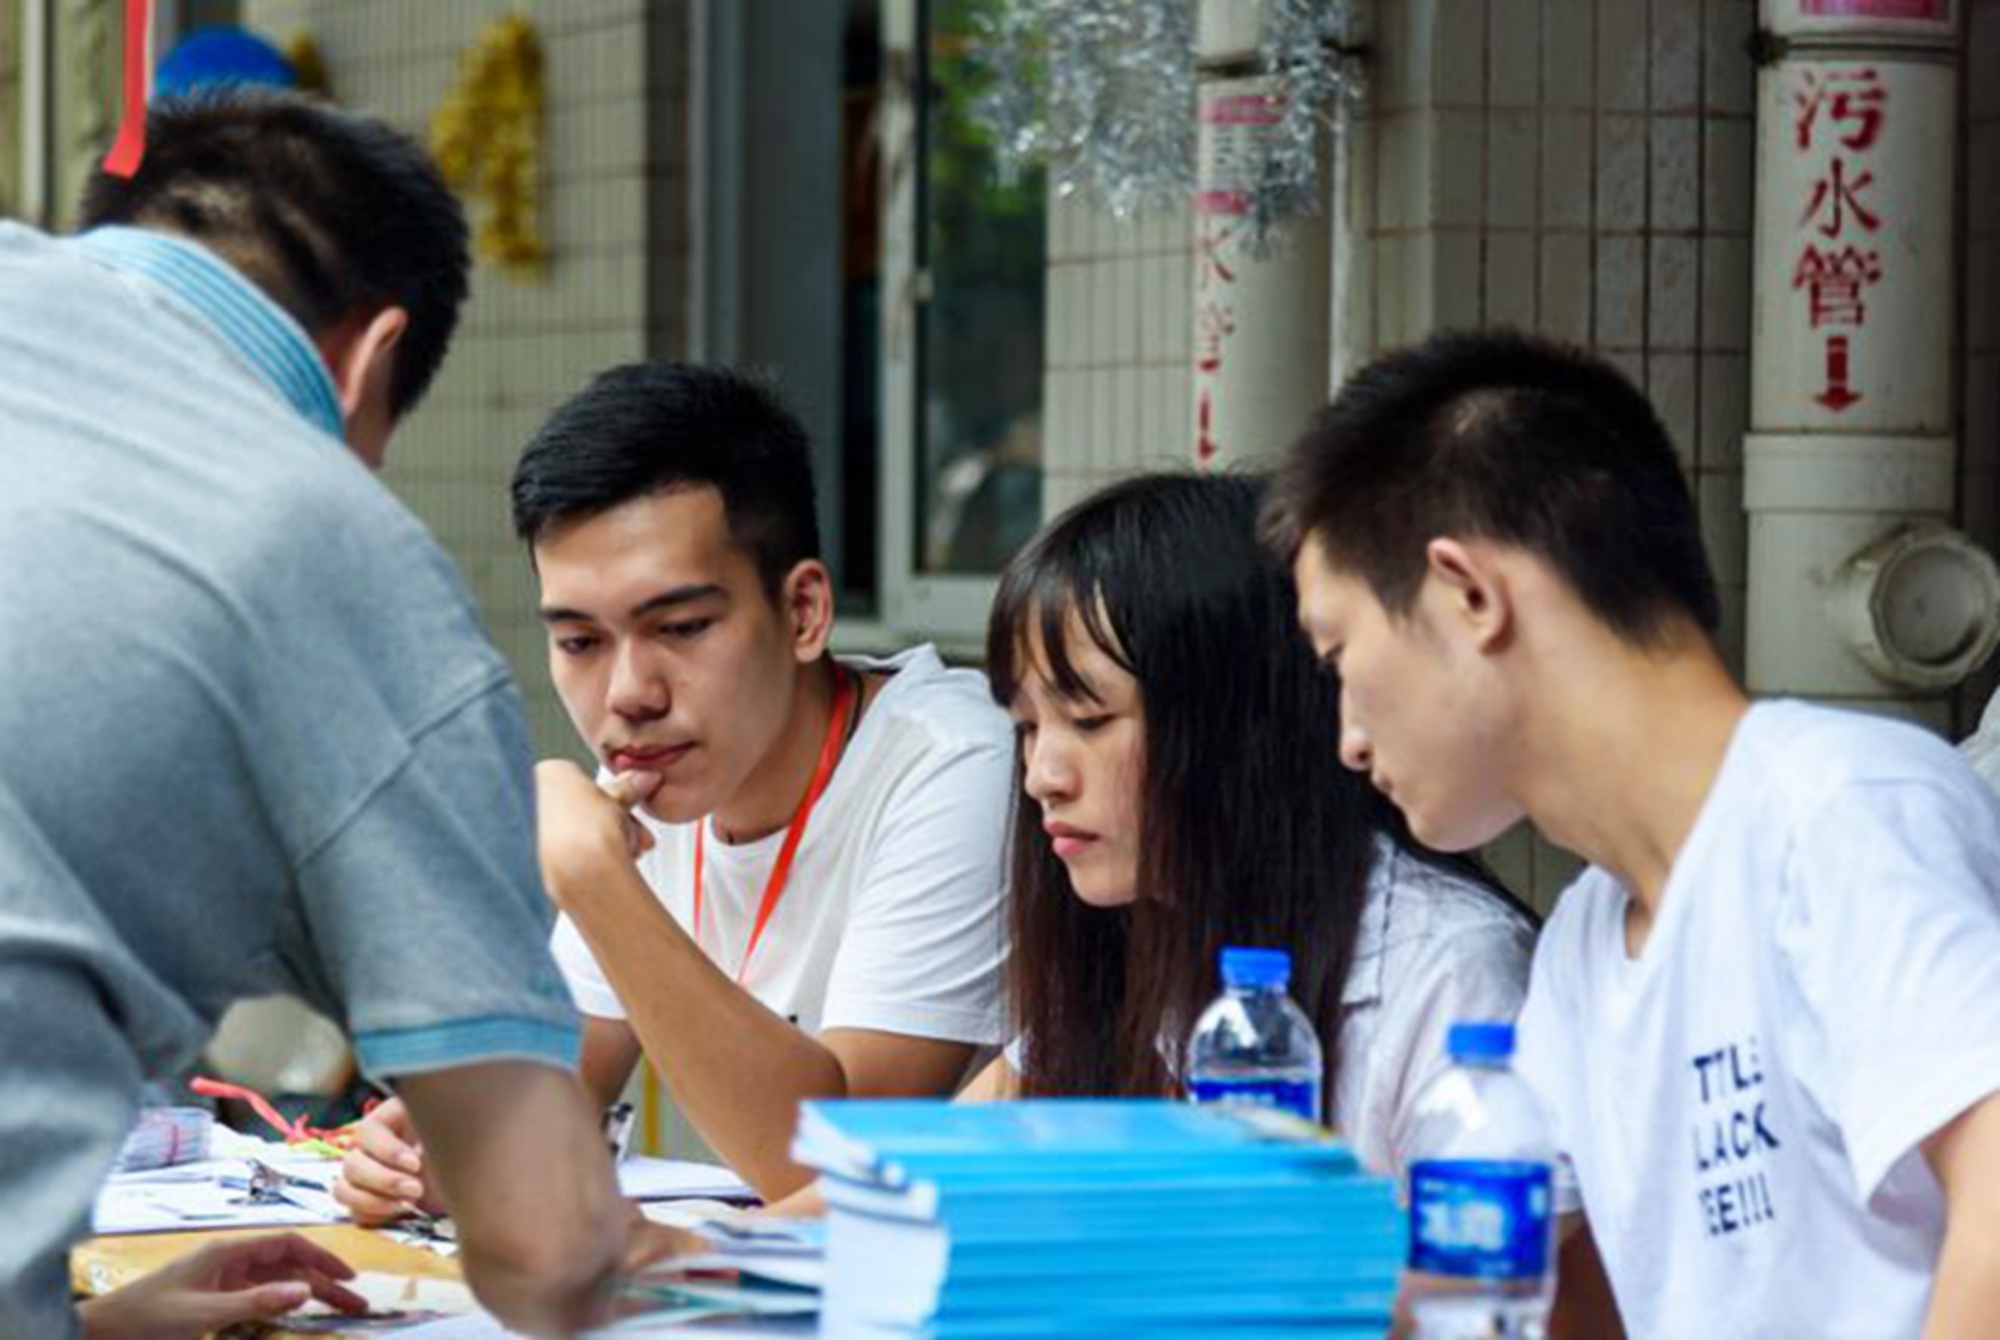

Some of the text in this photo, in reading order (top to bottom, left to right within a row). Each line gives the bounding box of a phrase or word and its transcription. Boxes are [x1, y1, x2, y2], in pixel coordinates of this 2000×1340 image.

[1792, 69, 1886, 328] 污水管
[1693, 1101, 1781, 1171] LACK
